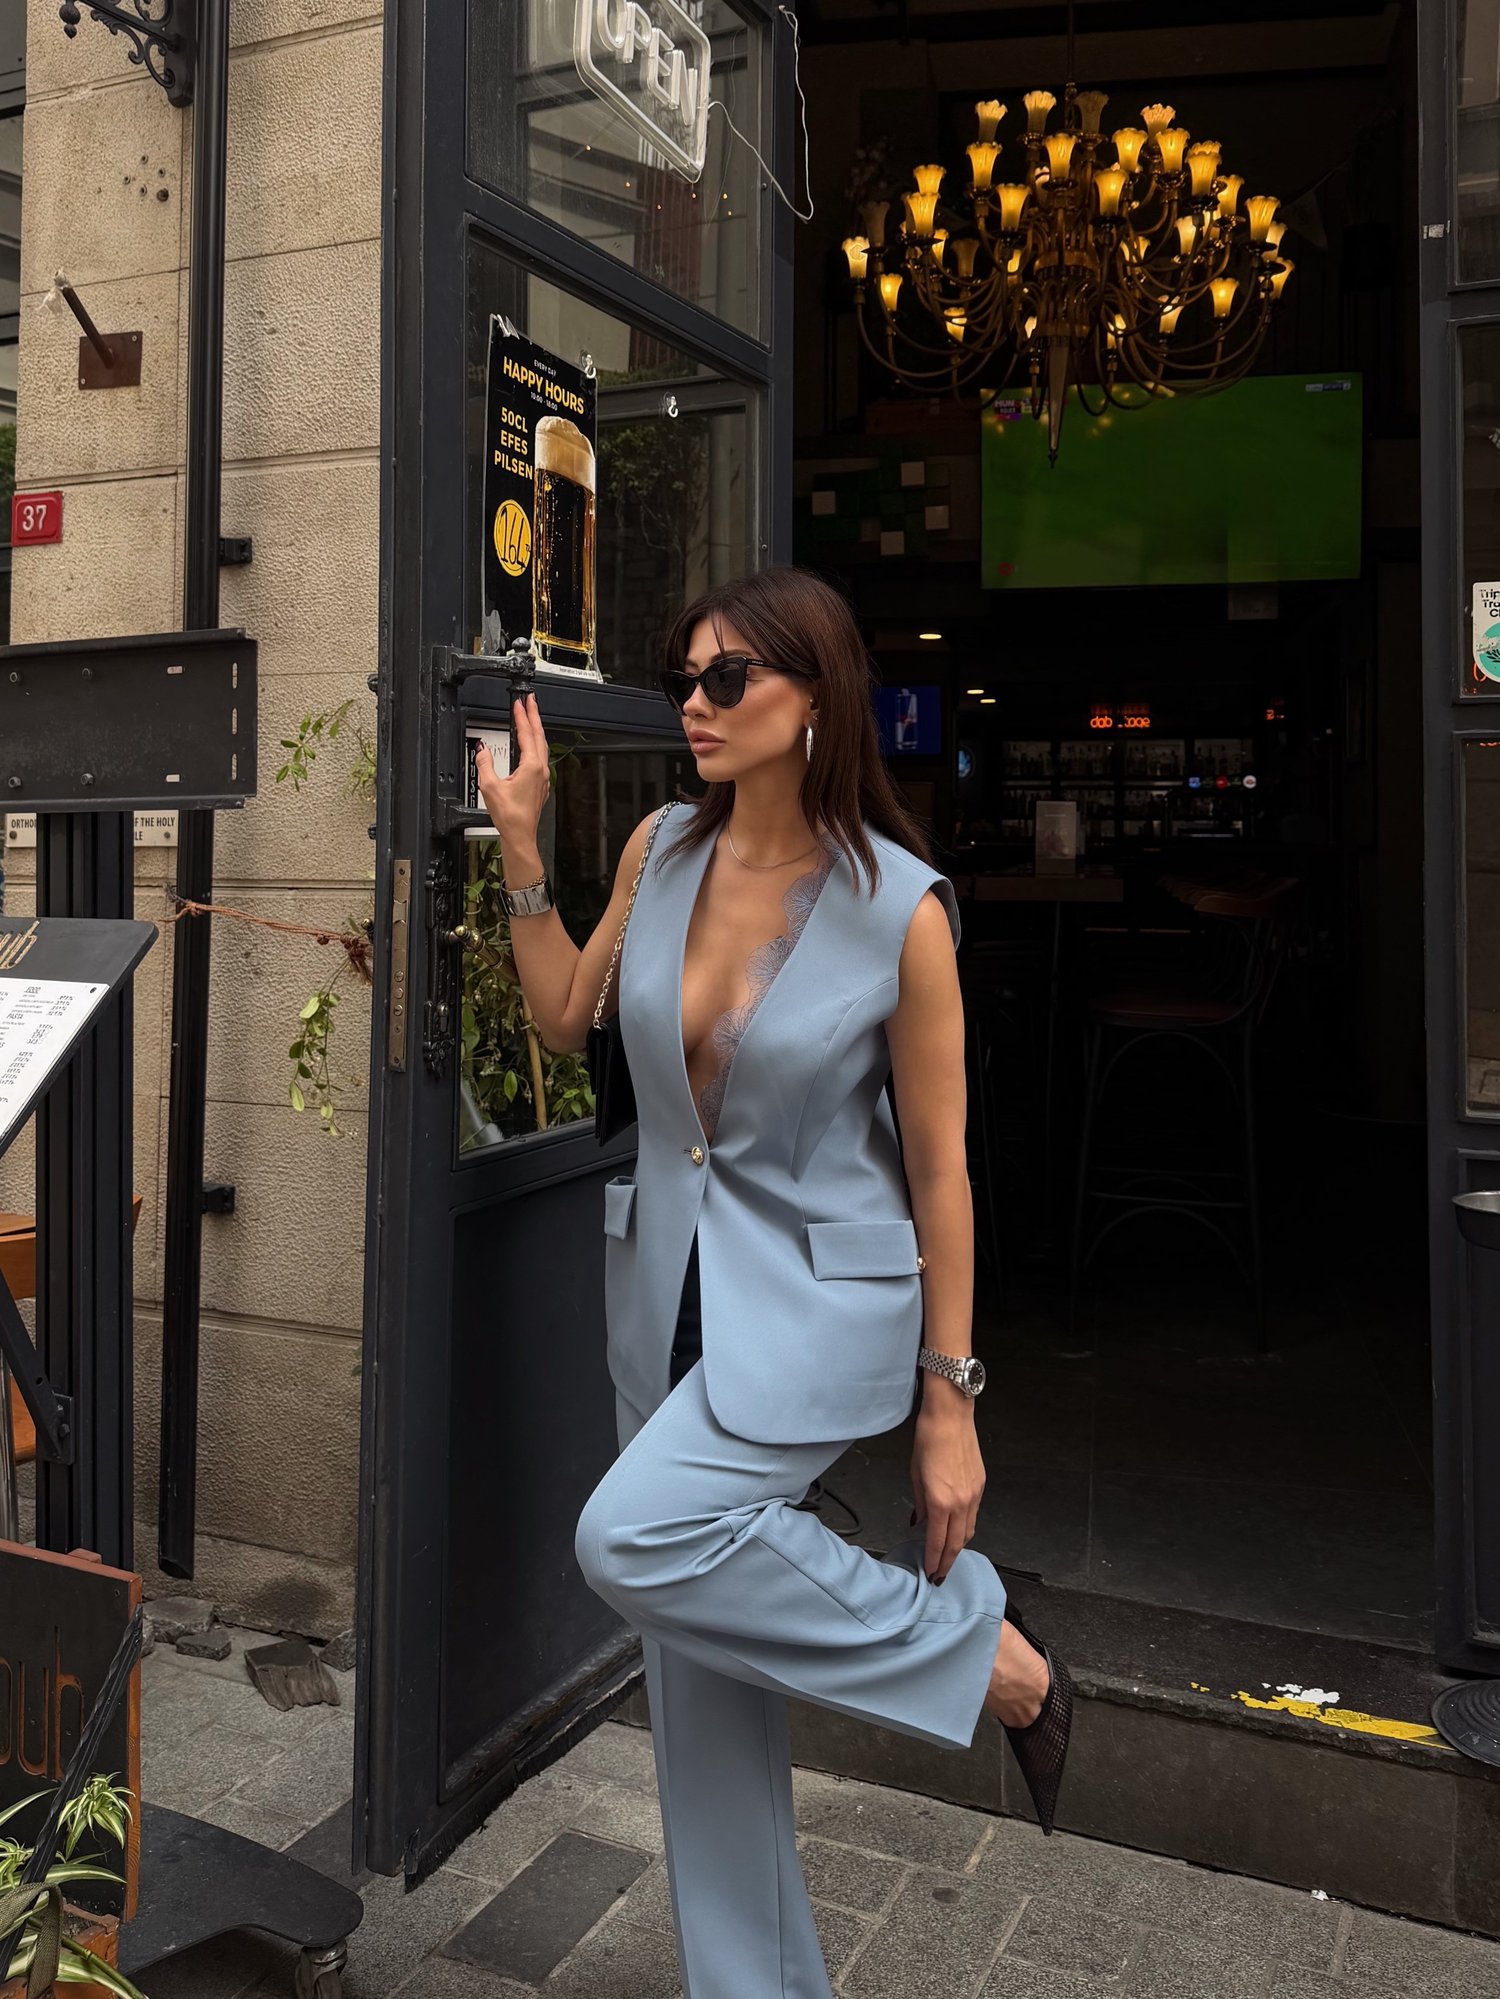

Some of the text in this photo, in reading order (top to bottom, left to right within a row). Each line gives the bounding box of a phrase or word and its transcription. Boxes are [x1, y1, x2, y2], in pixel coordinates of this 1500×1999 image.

[534, 359, 557, 377] EVERY DAY
[503, 356, 543, 393] HAPPY
[545, 379, 585, 415] HOURS
[501, 406, 528, 434] 50CL
[500, 430, 528, 456] EFES
[494, 449, 533, 480] PILSEN
[22, 504, 47, 531] 37
[140, 817, 154, 827] THE
[156, 816, 176, 827] HOLY
